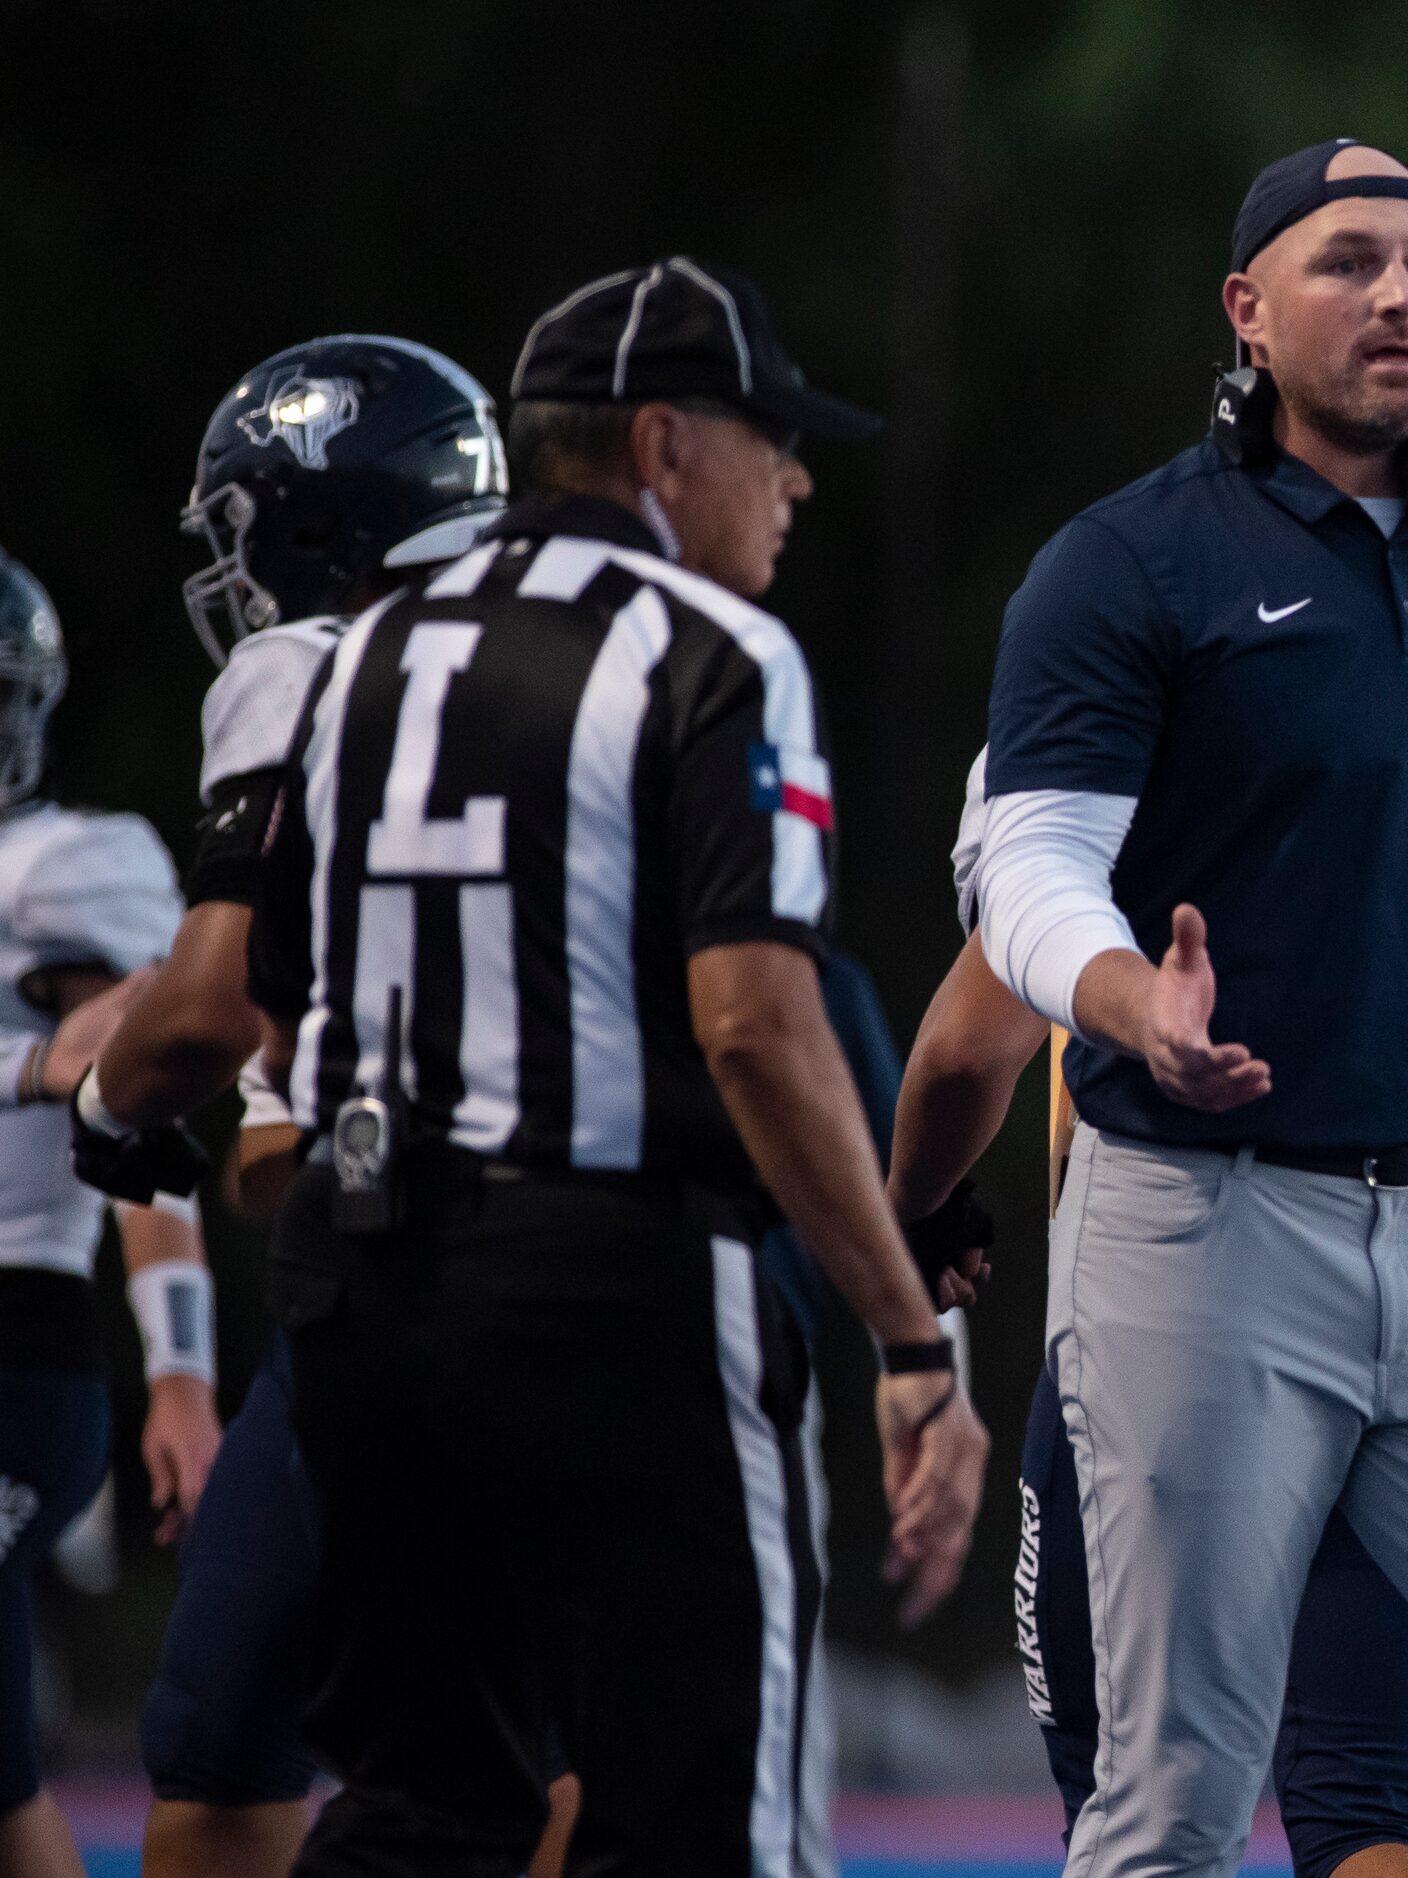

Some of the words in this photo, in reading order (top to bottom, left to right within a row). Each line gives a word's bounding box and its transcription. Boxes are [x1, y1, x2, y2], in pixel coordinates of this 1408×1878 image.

[1217, 397, 1236, 426] P
[366, 619, 508, 878] L
[1014, 1477, 1058, 1727] WARRIORS
